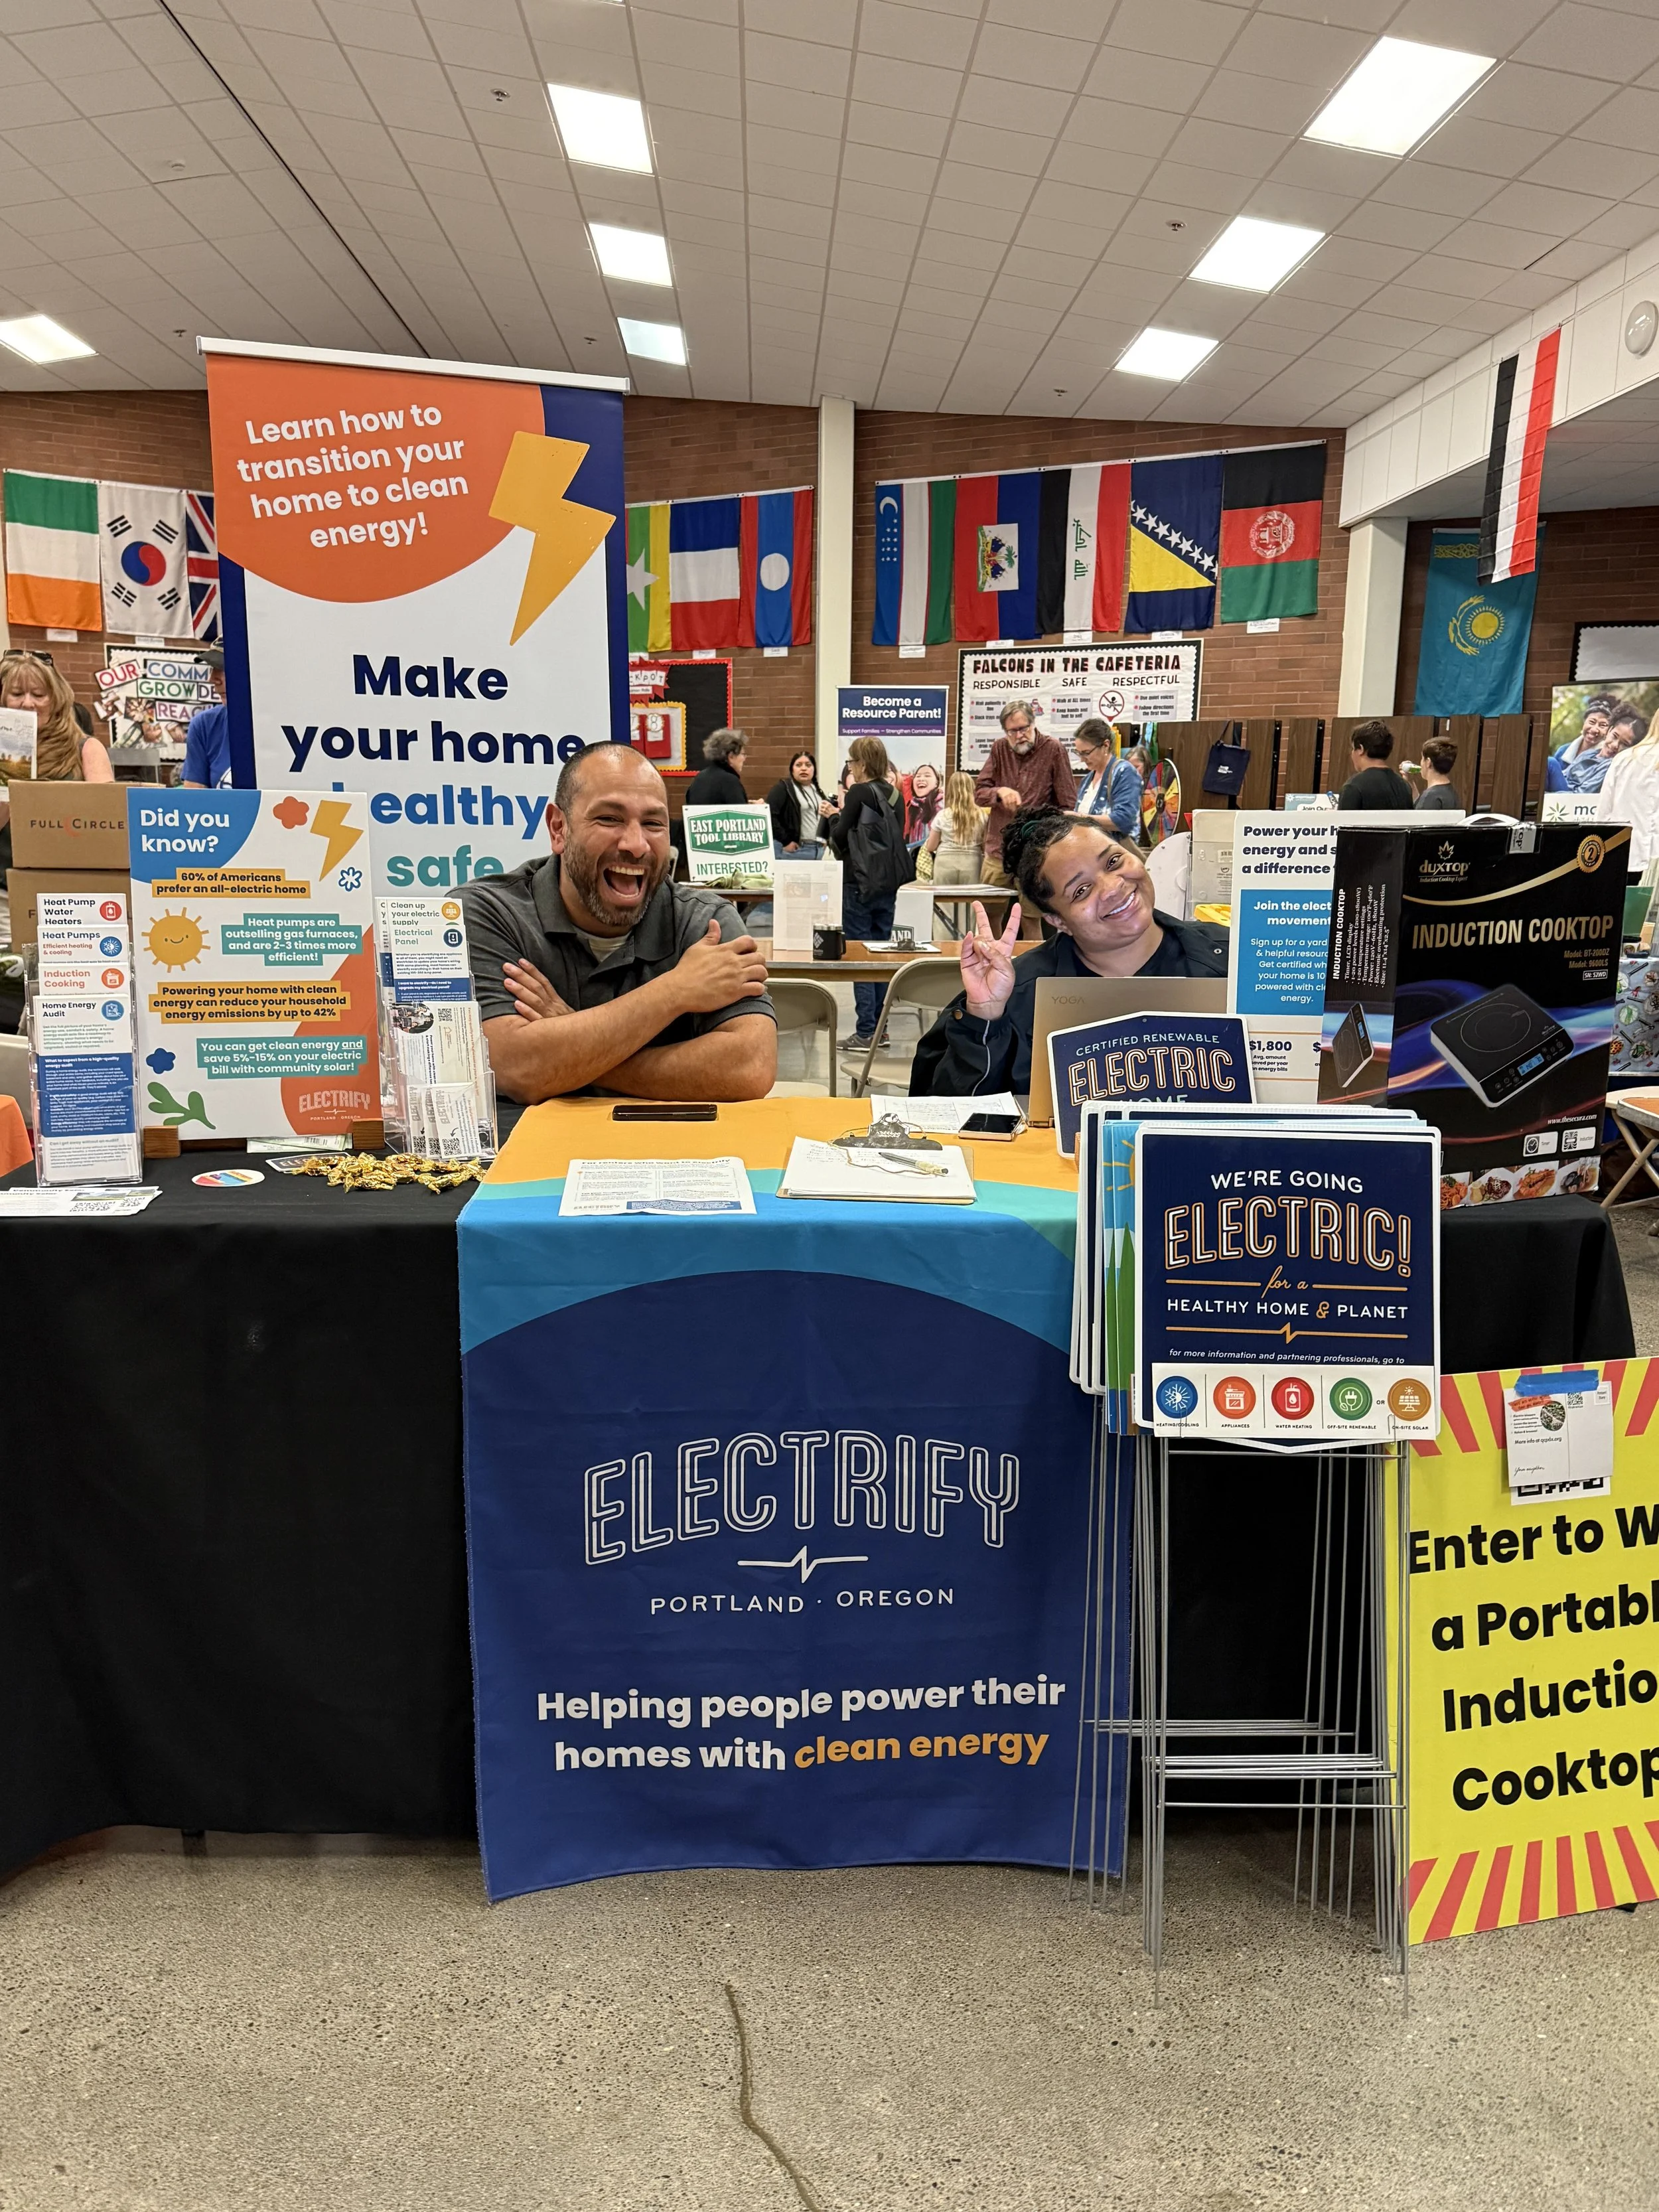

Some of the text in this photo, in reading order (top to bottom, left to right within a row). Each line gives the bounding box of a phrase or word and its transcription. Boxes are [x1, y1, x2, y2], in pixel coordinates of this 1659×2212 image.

[246, 405, 441, 443] Learn how to
[237, 441, 464, 482] transition your
[251, 477, 468, 518] home to clean
[311, 512, 427, 547] energy!
[99, 663, 138, 686] OUR
[973, 655, 1181, 674] FALCONS IN THE CAFETERIA
[353, 654, 508, 700] Make
[974, 675, 1179, 689] RESPONSIBLE SAFE RESPECTFUL
[139, 681, 195, 697] GROW
[842, 707, 942, 719] Resource Parent!
[863, 696, 922, 707] Become a
[281, 721, 585, 771] your home
[141, 809, 229, 832] Did you
[332, 782, 549, 839] ealthy
[30, 820, 64, 828] FULL
[690, 818, 766, 833] EAST PORTLAND
[1244, 826, 1327, 838] Power your
[142, 835, 218, 852] know?
[695, 832, 764, 846] TOOL LIBRARY
[1242, 846, 1327, 858] energy and
[220, 873, 281, 881] Americans
[386, 845, 504, 887] safe
[697, 861, 768, 875] INTERESTED?
[1242, 863, 1330, 874] a difference
[1419, 860, 1469, 875] duxtop
[157, 884, 191, 895] prefer
[1333, 889, 1345, 979] INDUCTION COOKTOP
[1412, 915, 1614, 948] INDUCTION COOKTOP
[1564, 948, 1610, 958] Model: BT-200DZ
[44, 980, 84, 988] Cooking
[1051, 996, 1085, 1005] YOGA
[1076, 1033, 1220, 1057] CERTIFIED RENEWABLE
[1250, 1041, 1291, 1052] $1,800
[1068, 1046, 1236, 1107] ELECTRIC
[299, 1090, 370, 1113] ELECTRIFY
[1211, 1169, 1363, 1193] WE'RE GOING
[1165, 1196, 1411, 1278] ELECTRIC!
[1262, 1265, 1309, 1298] for a
[1168, 1299, 1407, 1318] HEALTHY HOME & PLANET
[1277, 1354, 1321, 1363] partnering
[1324, 1355, 1380, 1364] professionals,
[1396, 1357, 1406, 1366] to
[585, 1430, 1019, 1566] ELECTRIFY
[1410, 1515, 1603, 1574] Enter to
[652, 1589, 952, 1614] PORTLAND OREGON
[1432, 1580, 1659, 1652] a Portabl
[538, 1674, 1065, 1728] Helping people power their
[1443, 1661, 1659, 1733] Inductio
[556, 1733, 1048, 1771] homes with clean energy
